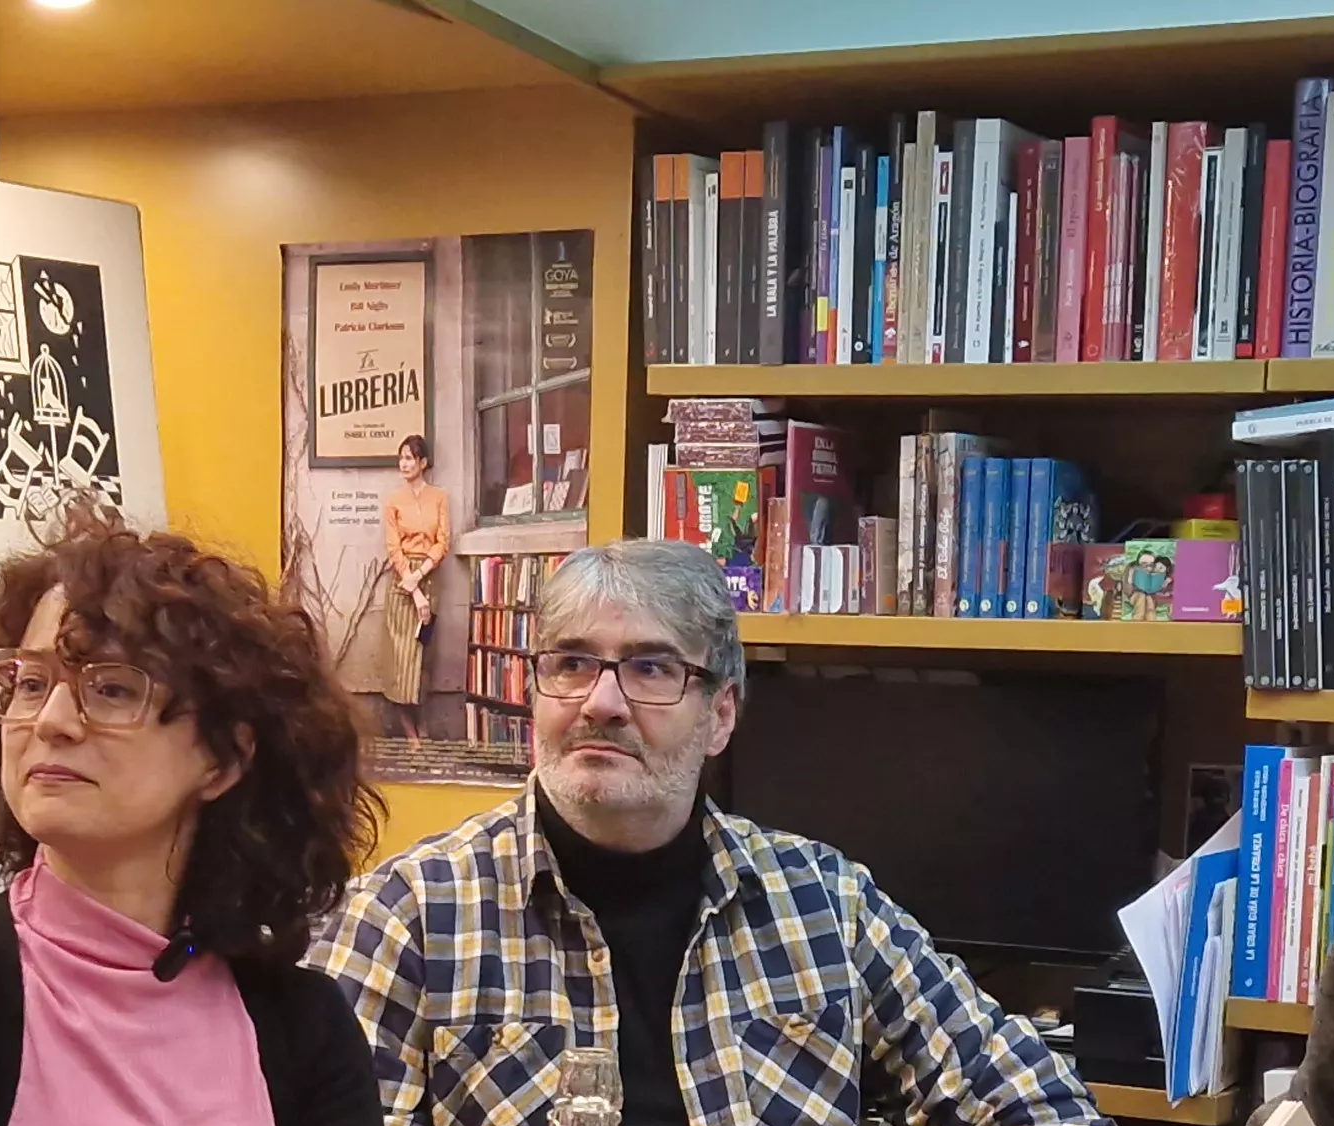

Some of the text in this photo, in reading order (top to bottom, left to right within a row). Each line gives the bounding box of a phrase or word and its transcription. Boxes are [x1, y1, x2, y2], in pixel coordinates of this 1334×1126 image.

[767, 211, 778, 252] PALABRA
[885, 201, 903, 258] de Aragón
[1289, 94, 1322, 344] HISTORIA-BIOGRAFIA
[766, 255, 778, 266] LA
[545, 268, 579, 282] GOYA
[766, 279, 777, 301] BALA
[766, 304, 777, 316] LA
[334, 322, 366, 332] Patricia
[319, 361, 420, 418] LIBRERÍA
[1280, 803, 1289, 816] De
[1278, 818, 1288, 843] chica
[1276, 853, 1285, 878] chica
[1245, 833, 1262, 960] LA GRAN GUÍA DE LA CRIANZA
